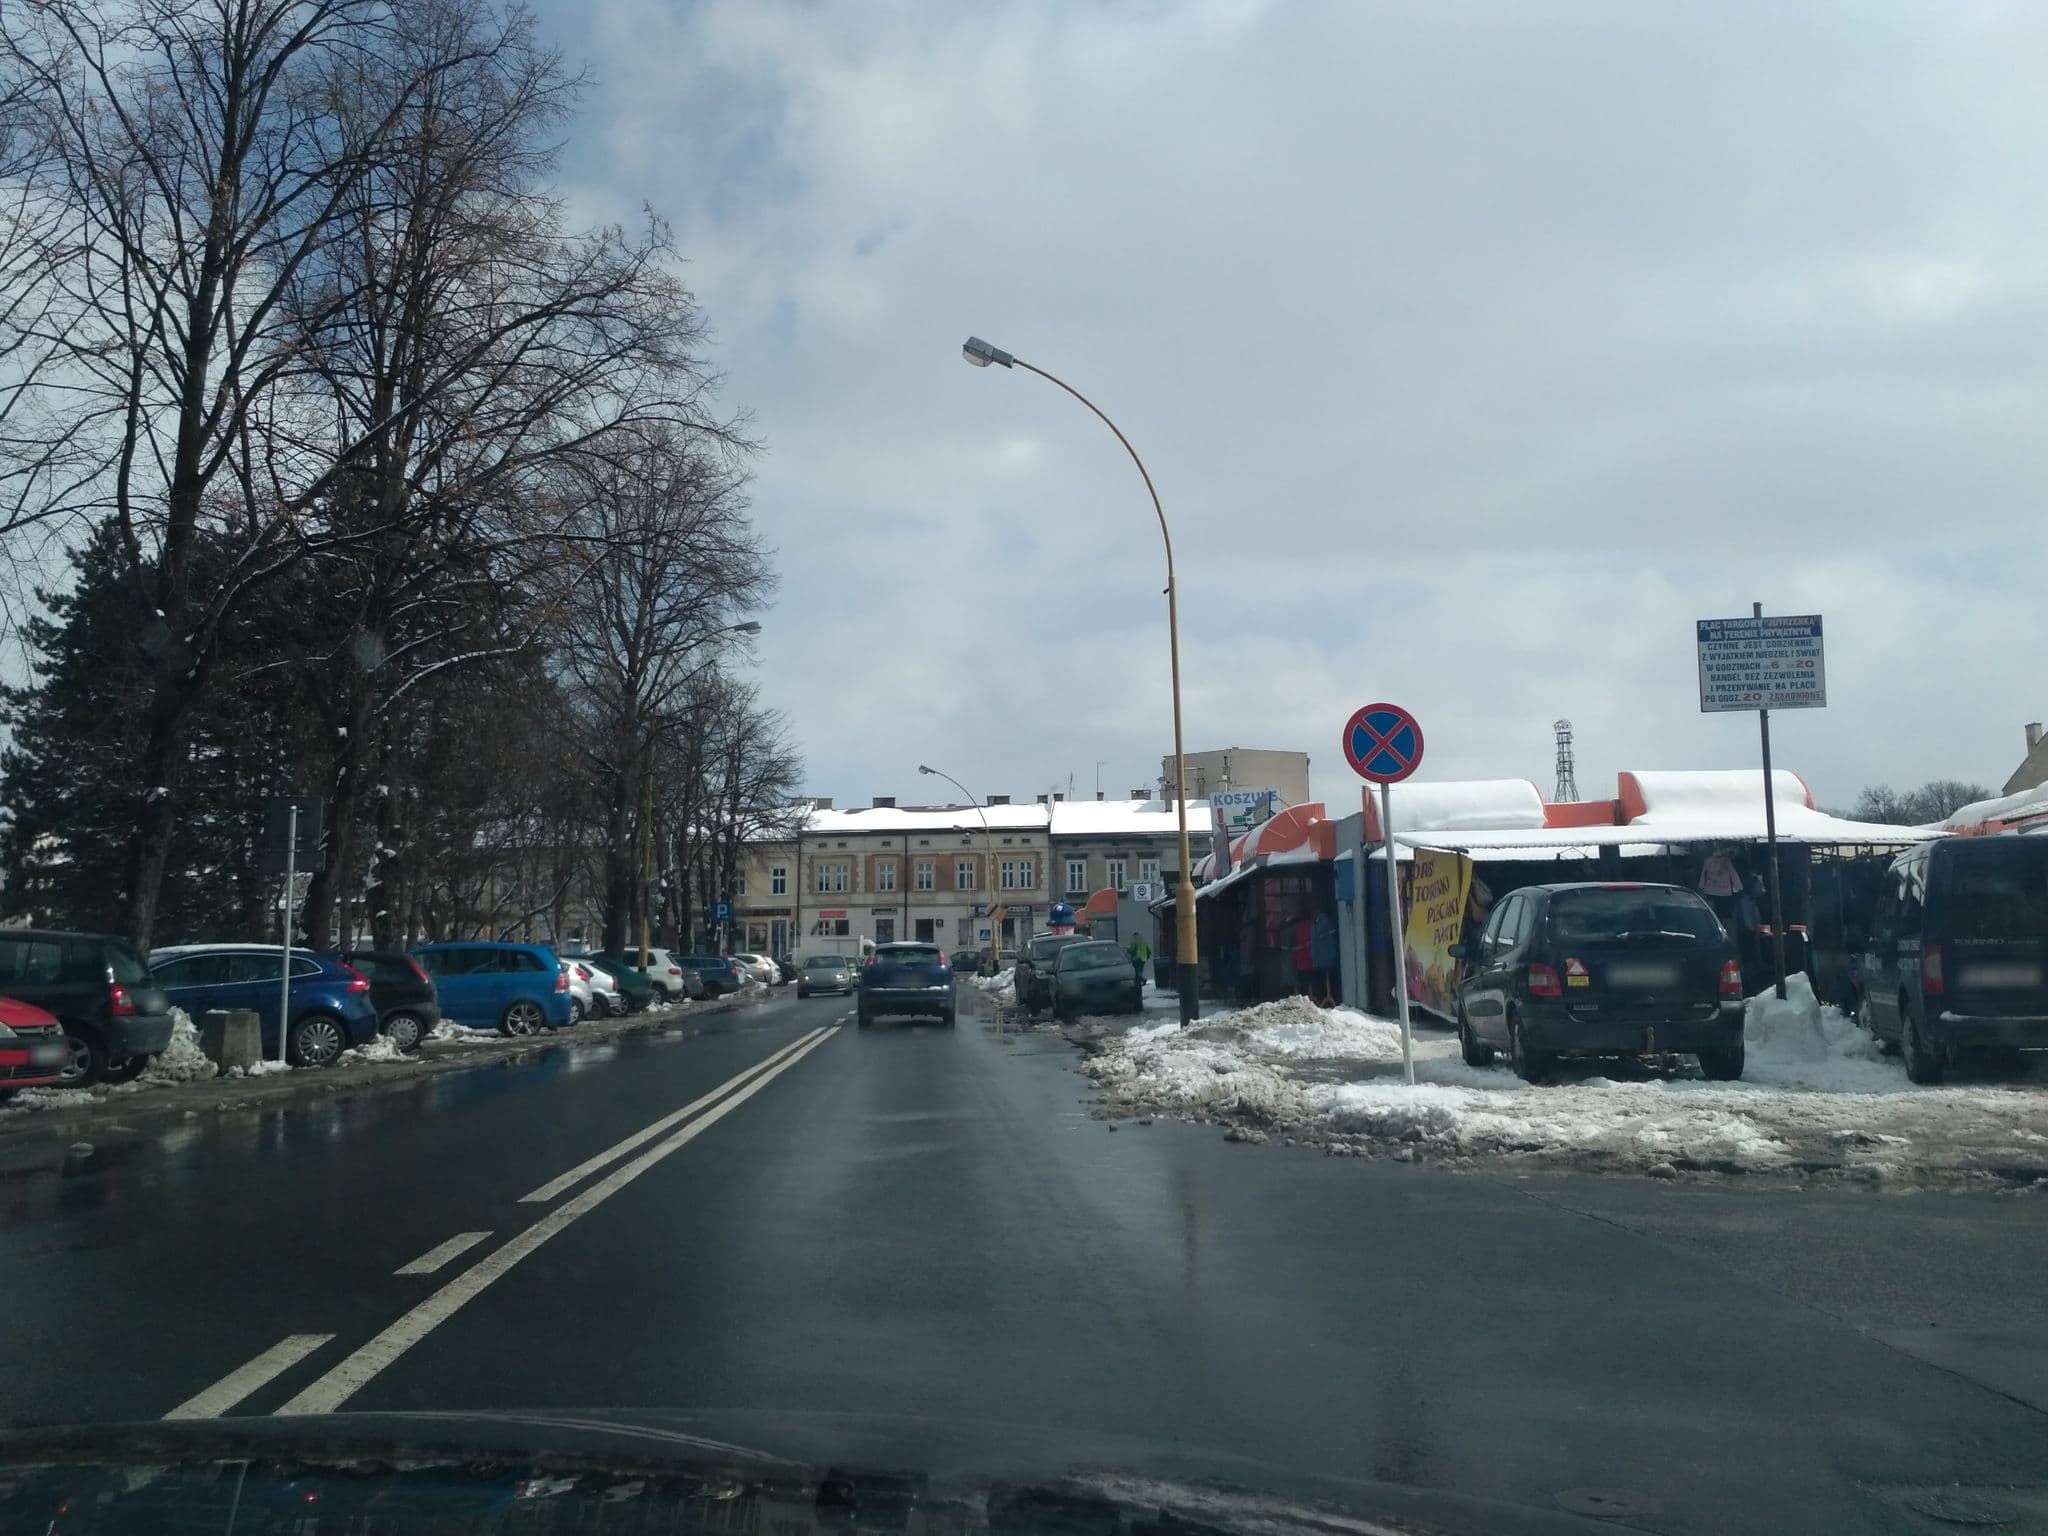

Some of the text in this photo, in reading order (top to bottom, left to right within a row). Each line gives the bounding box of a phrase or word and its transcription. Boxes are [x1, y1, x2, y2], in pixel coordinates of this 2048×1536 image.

[1707, 642, 1739, 650] CZYNNE
[1743, 640, 1762, 650] JEST
[1706, 664, 1714, 672] W
[1771, 660, 1780, 669] 6
[1796, 660, 1815, 668] 20
[1710, 674, 1742, 682] HANDEL
[1764, 670, 1816, 680] ZEZWOLENIA
[1716, 682, 1771, 692] PRZEBYWANIE
[1775, 682, 1786, 690] NA
[1790, 681, 1816, 690] PLACU
[1705, 695, 1716, 703] PO
[1743, 693, 1762, 702] 20
